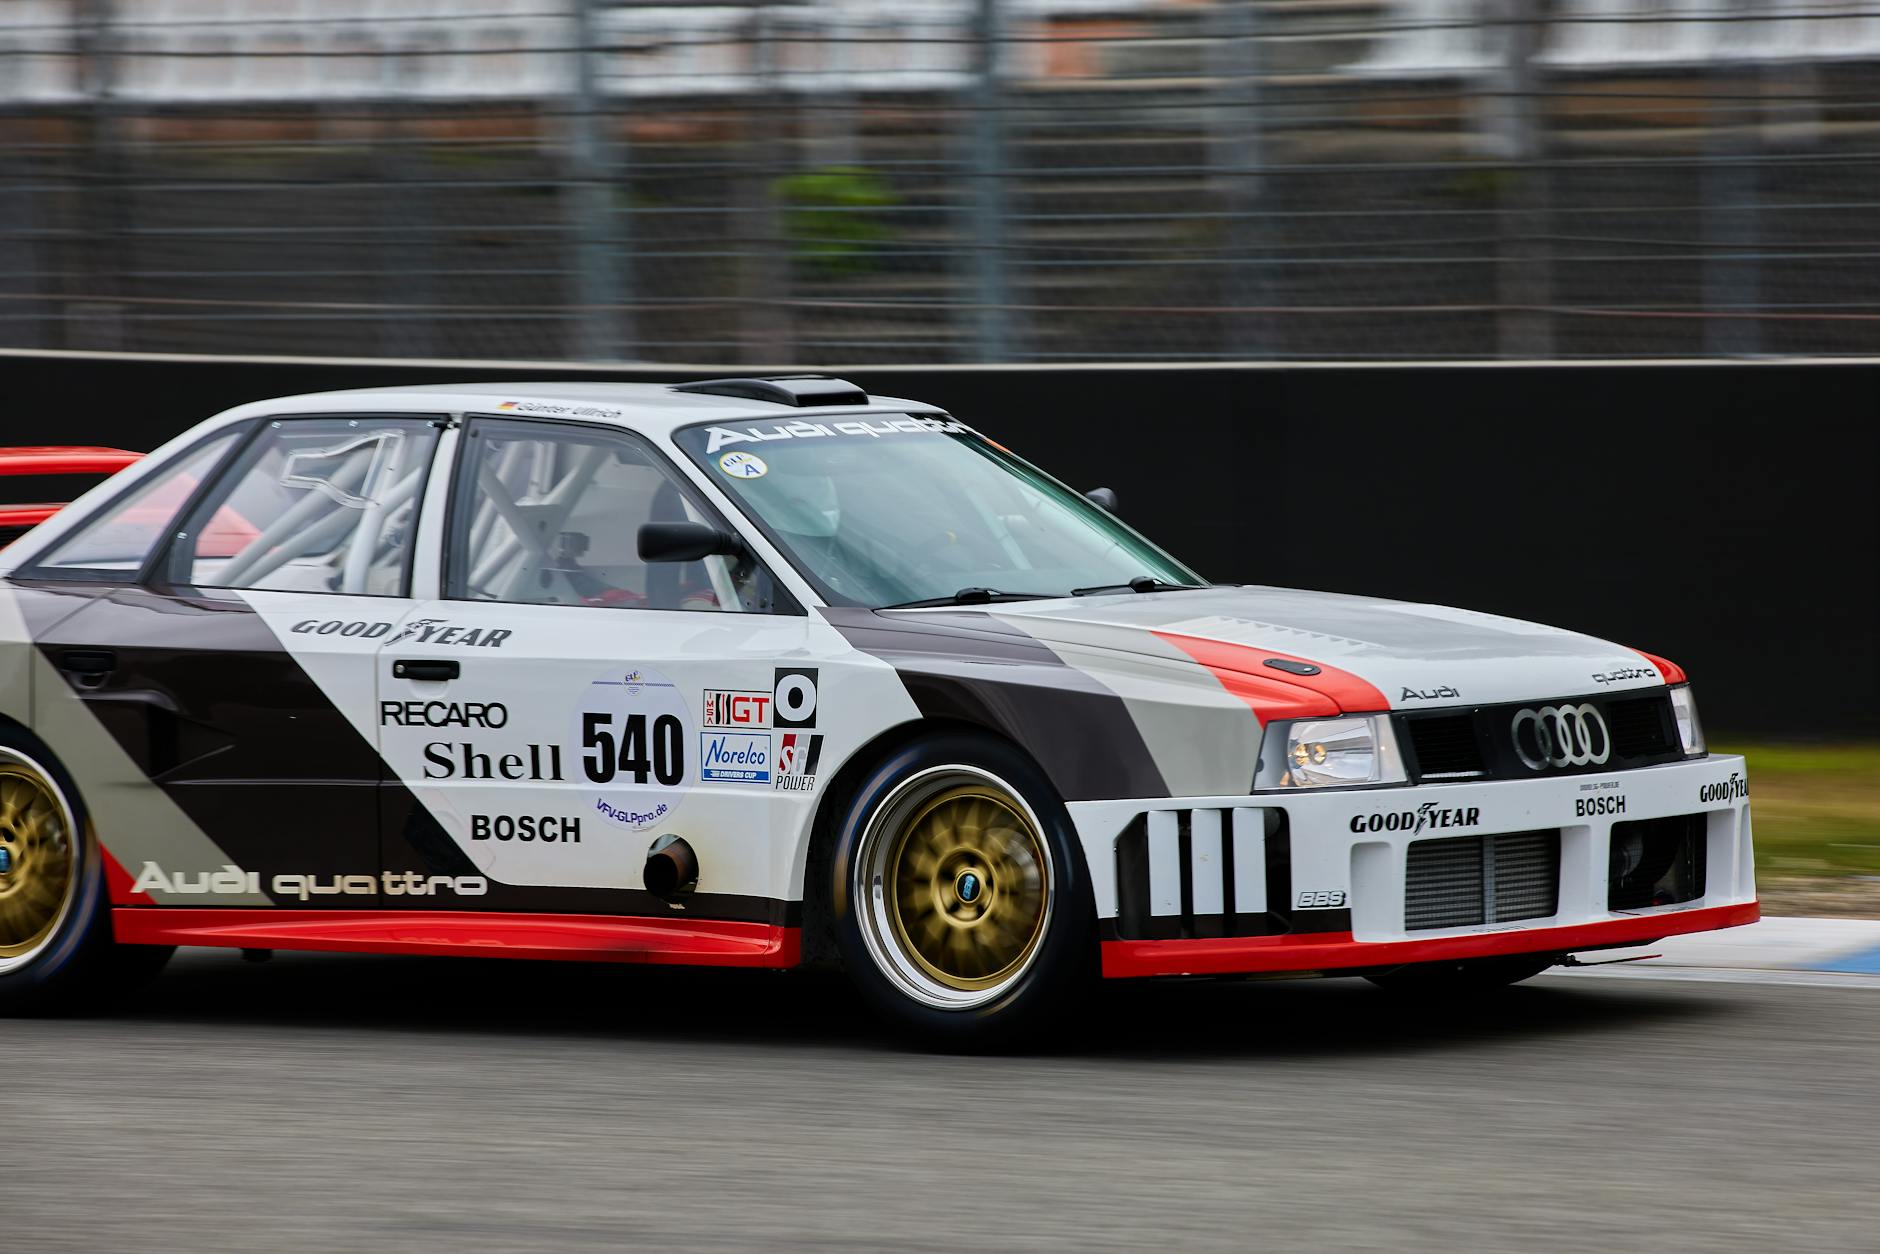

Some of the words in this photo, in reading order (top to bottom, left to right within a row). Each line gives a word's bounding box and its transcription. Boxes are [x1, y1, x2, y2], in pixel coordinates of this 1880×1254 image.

[704, 420, 836, 454] Audi
[745, 464, 761, 476] A
[291, 619, 393, 639] GOOD
[416, 625, 513, 648] YEAR
[1592, 667, 1656, 686] quattro
[1400, 685, 1461, 702] Audi
[381, 700, 508, 728] RECARO
[706, 692, 714, 724] IMSA
[732, 696, 770, 723] GT
[423, 741, 565, 781] Shell
[582, 712, 684, 786] 540
[705, 735, 766, 767] Norelco
[744, 771, 757, 780] CUP
[775, 775, 816, 791] POWER
[1700, 781, 1729, 803] GOOD
[596, 798, 668, 825] VFV-GLPpro.de
[1576, 795, 1626, 817] BOSCH
[471, 814, 581, 843] BOSCH
[1350, 811, 1415, 833] GOOD
[1429, 807, 1480, 829] YEAR
[130, 861, 260, 894] Audi
[272, 870, 488, 900] quattro
[1297, 890, 1346, 908] BBS
